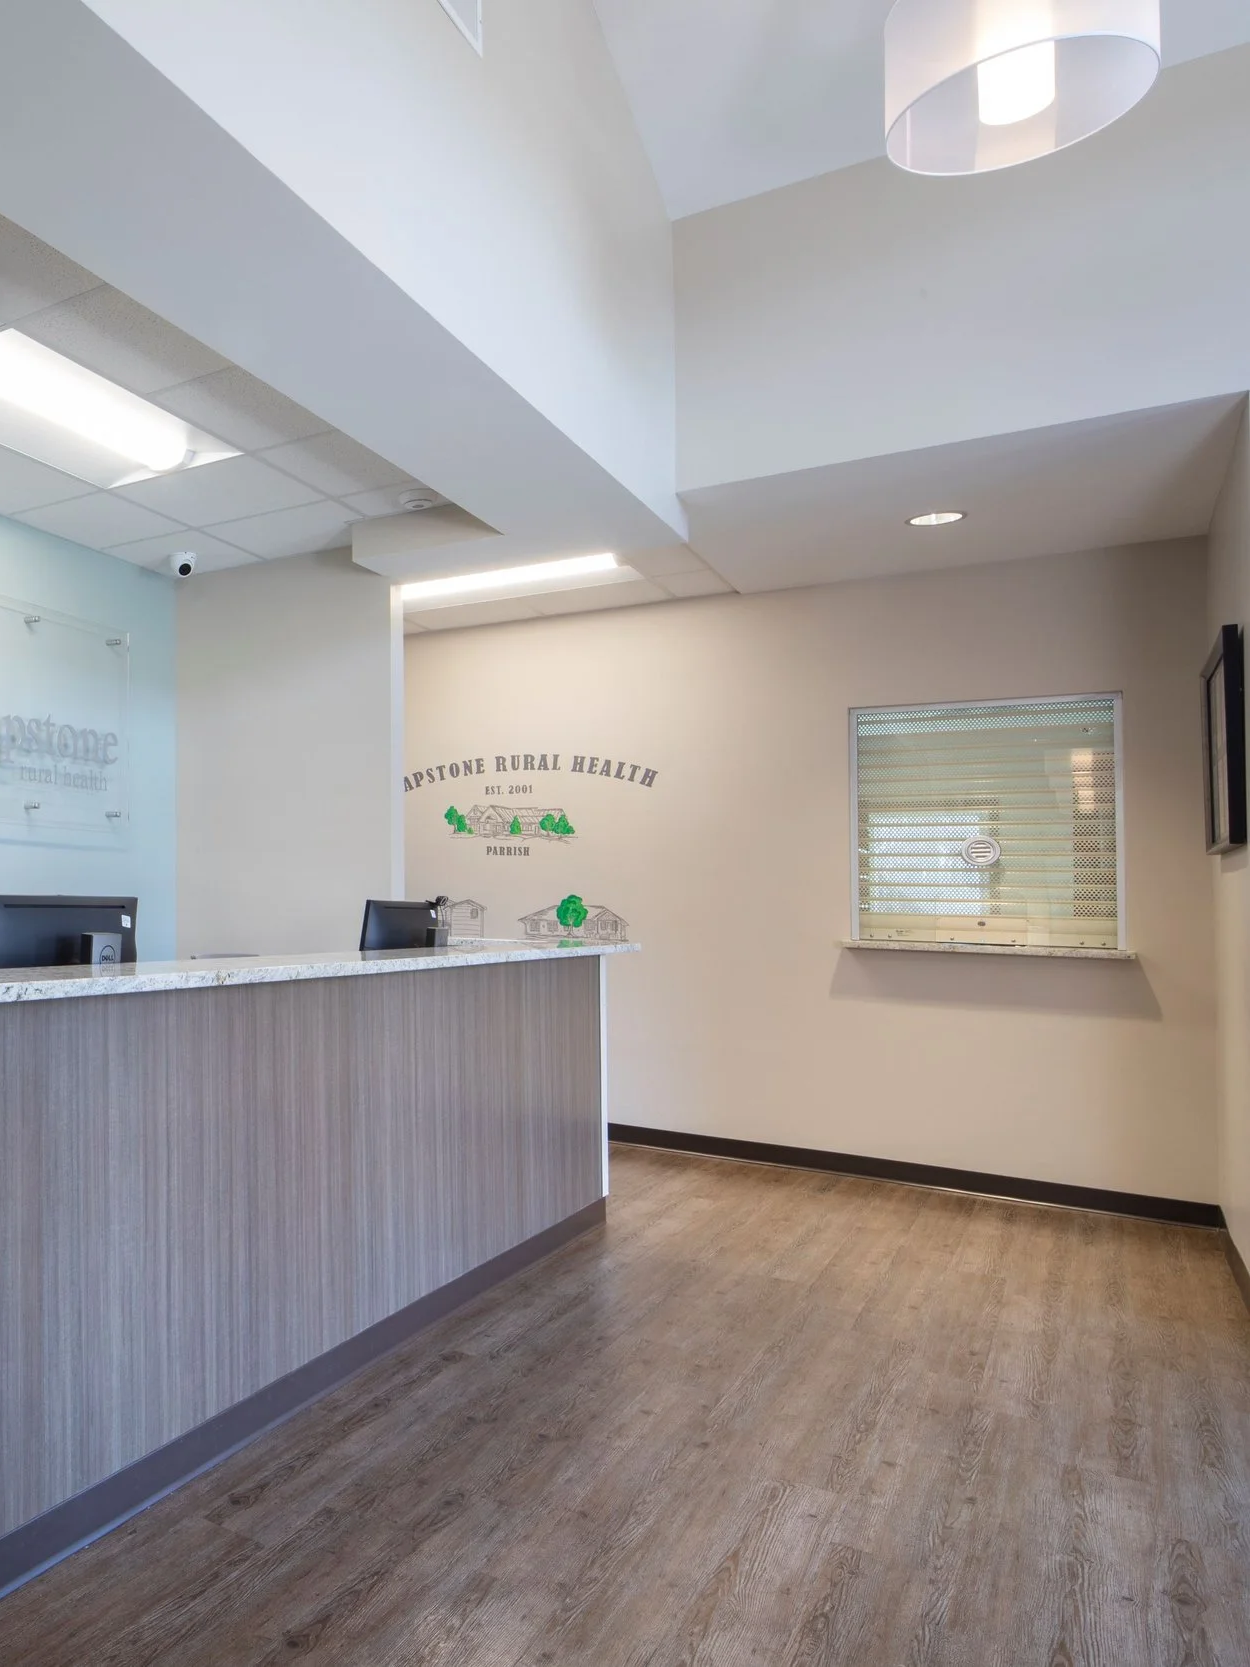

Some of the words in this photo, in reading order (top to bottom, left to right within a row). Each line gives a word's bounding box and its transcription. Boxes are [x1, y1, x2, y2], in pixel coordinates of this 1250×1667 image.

[20, 764, 57, 785] rural
[63, 766, 108, 791] health
[403, 757, 485, 792] APSTONE
[494, 753, 561, 773] RURAL
[570, 755, 659, 788] HEALTH
[485, 785, 504, 796] EST.
[508, 784, 534, 795] 2001
[486, 845, 531, 857] PARRISH
[101, 954, 114, 962] DELL
